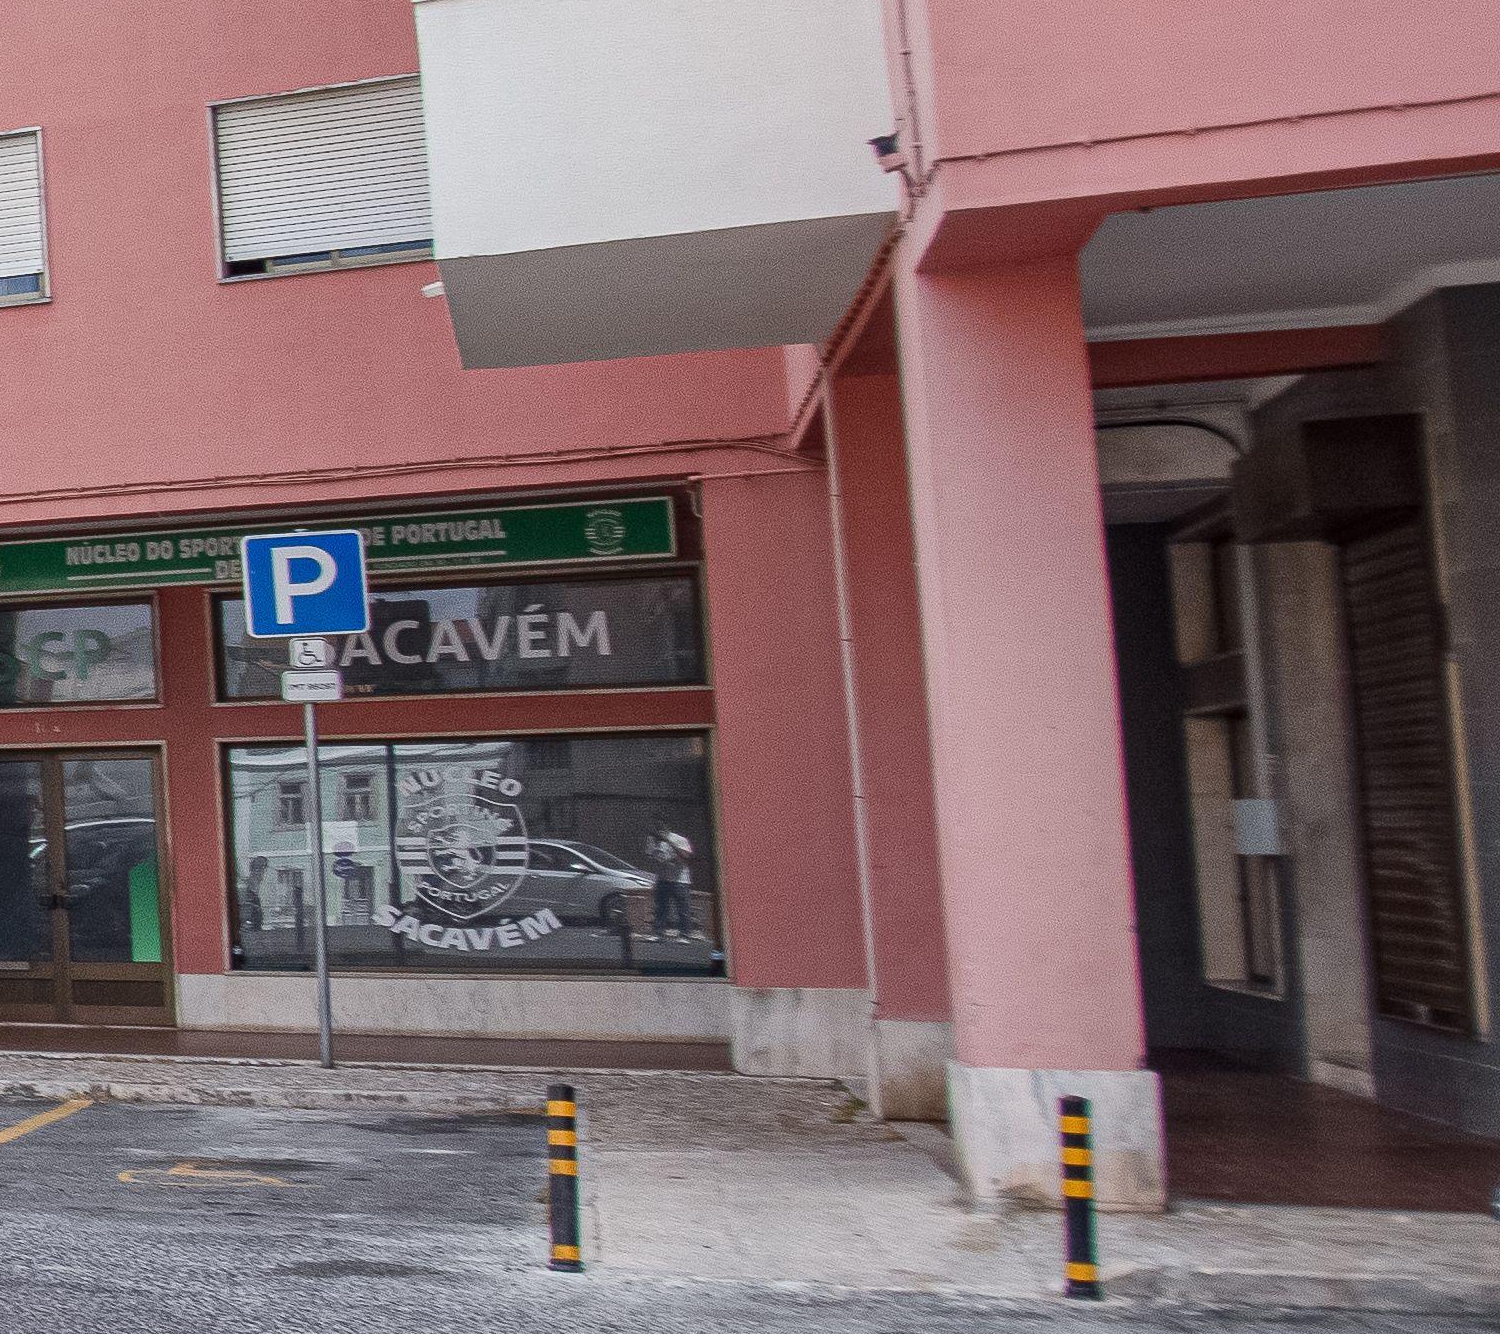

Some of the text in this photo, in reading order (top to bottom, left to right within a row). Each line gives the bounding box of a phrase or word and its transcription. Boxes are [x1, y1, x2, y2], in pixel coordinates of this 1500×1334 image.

[146, 540, 173, 560] DO
[391, 519, 506, 544] PORTUGAL
[268, 546, 338, 626] P
[372, 904, 563, 952] SACAVÉM
